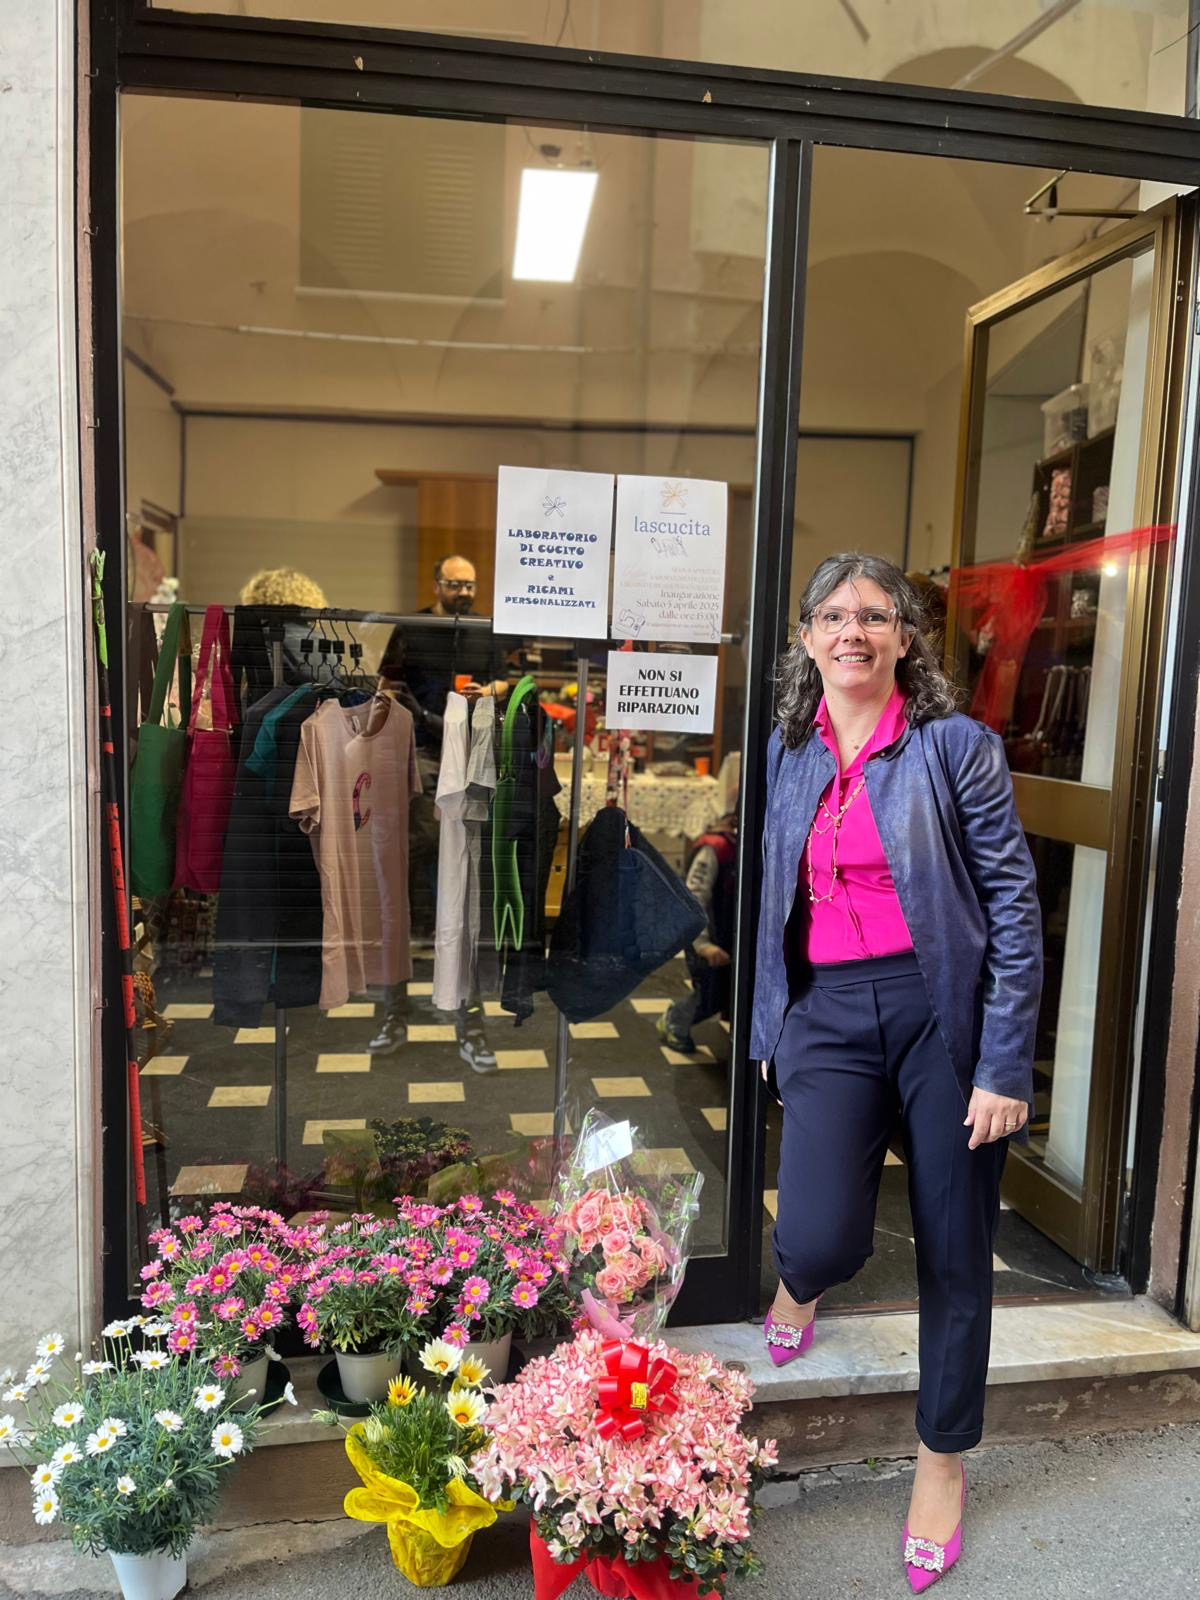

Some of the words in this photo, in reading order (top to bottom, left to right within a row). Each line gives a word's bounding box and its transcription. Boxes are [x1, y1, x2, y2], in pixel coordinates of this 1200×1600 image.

[634, 515, 711, 536] lascucita
[508, 529, 597, 542] LABORATORIO
[520, 543, 534, 552] DI
[537, 544, 585, 556] CUCITO
[520, 557, 584, 569] CREATIVO
[527, 584, 575, 596] RICAMI
[660, 590, 720, 600] Inaugurazione
[504, 596, 596, 609] PERSONALIZZATI
[636, 598, 666, 609] Sabato
[673, 601, 698, 611] aprile
[699, 601, 719, 611] 2025
[658, 610, 678, 620] dalle
[679, 612, 695, 621] ore
[638, 668, 666, 682] NON
[669, 670, 683, 682] SI
[619, 684, 700, 699] EFFETTUANO
[617, 701, 700, 716] RIPARAZIONI
